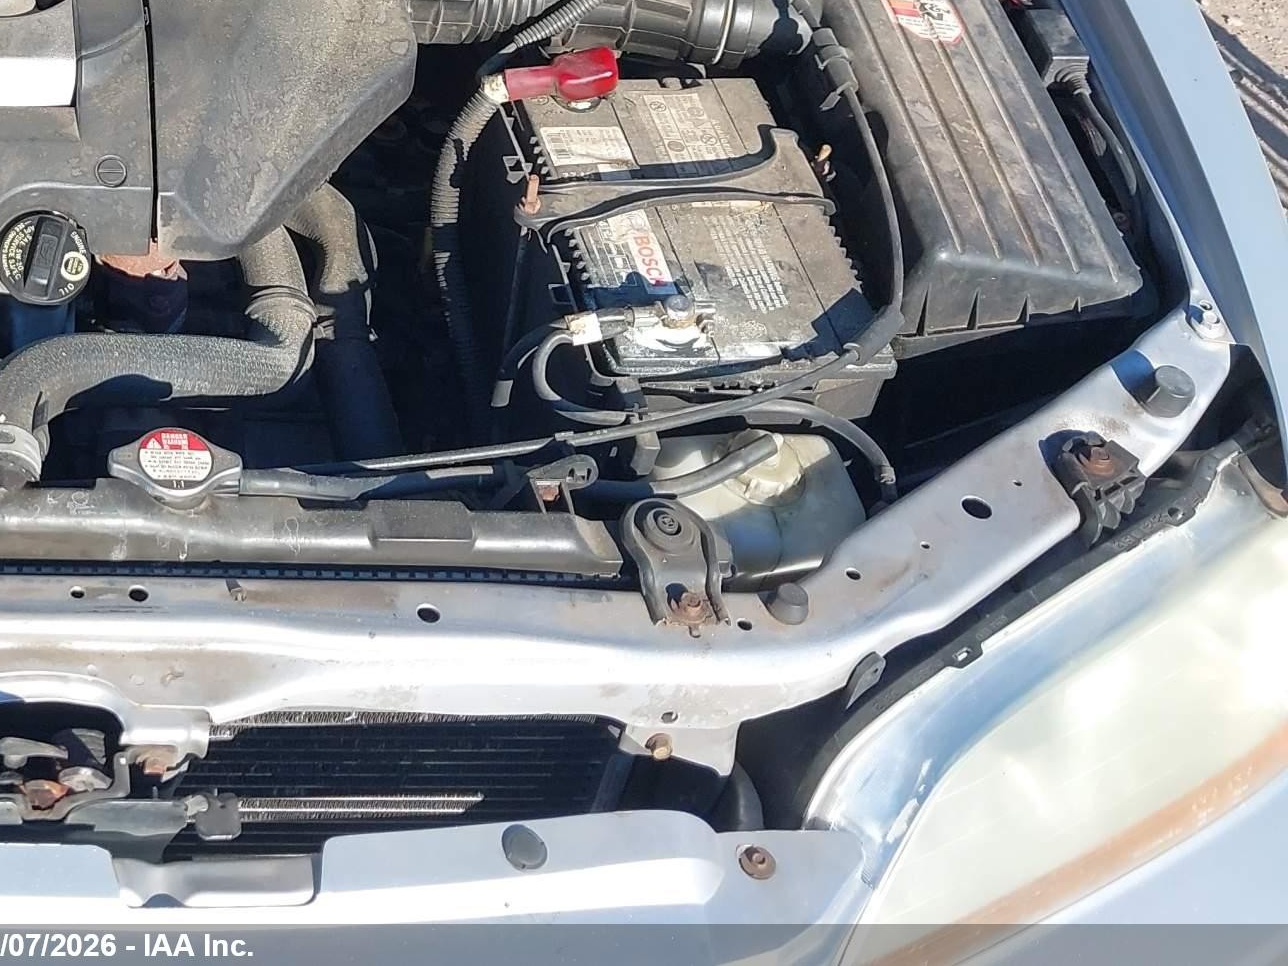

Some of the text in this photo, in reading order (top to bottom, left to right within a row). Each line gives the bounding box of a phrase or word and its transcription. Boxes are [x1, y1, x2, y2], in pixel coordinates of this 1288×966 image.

[8, 231, 26, 258] SERVICE
[70, 231, 87, 256] ENGINE
[633, 235, 668, 288] BOSCH
[58, 283, 75, 296] OIL
